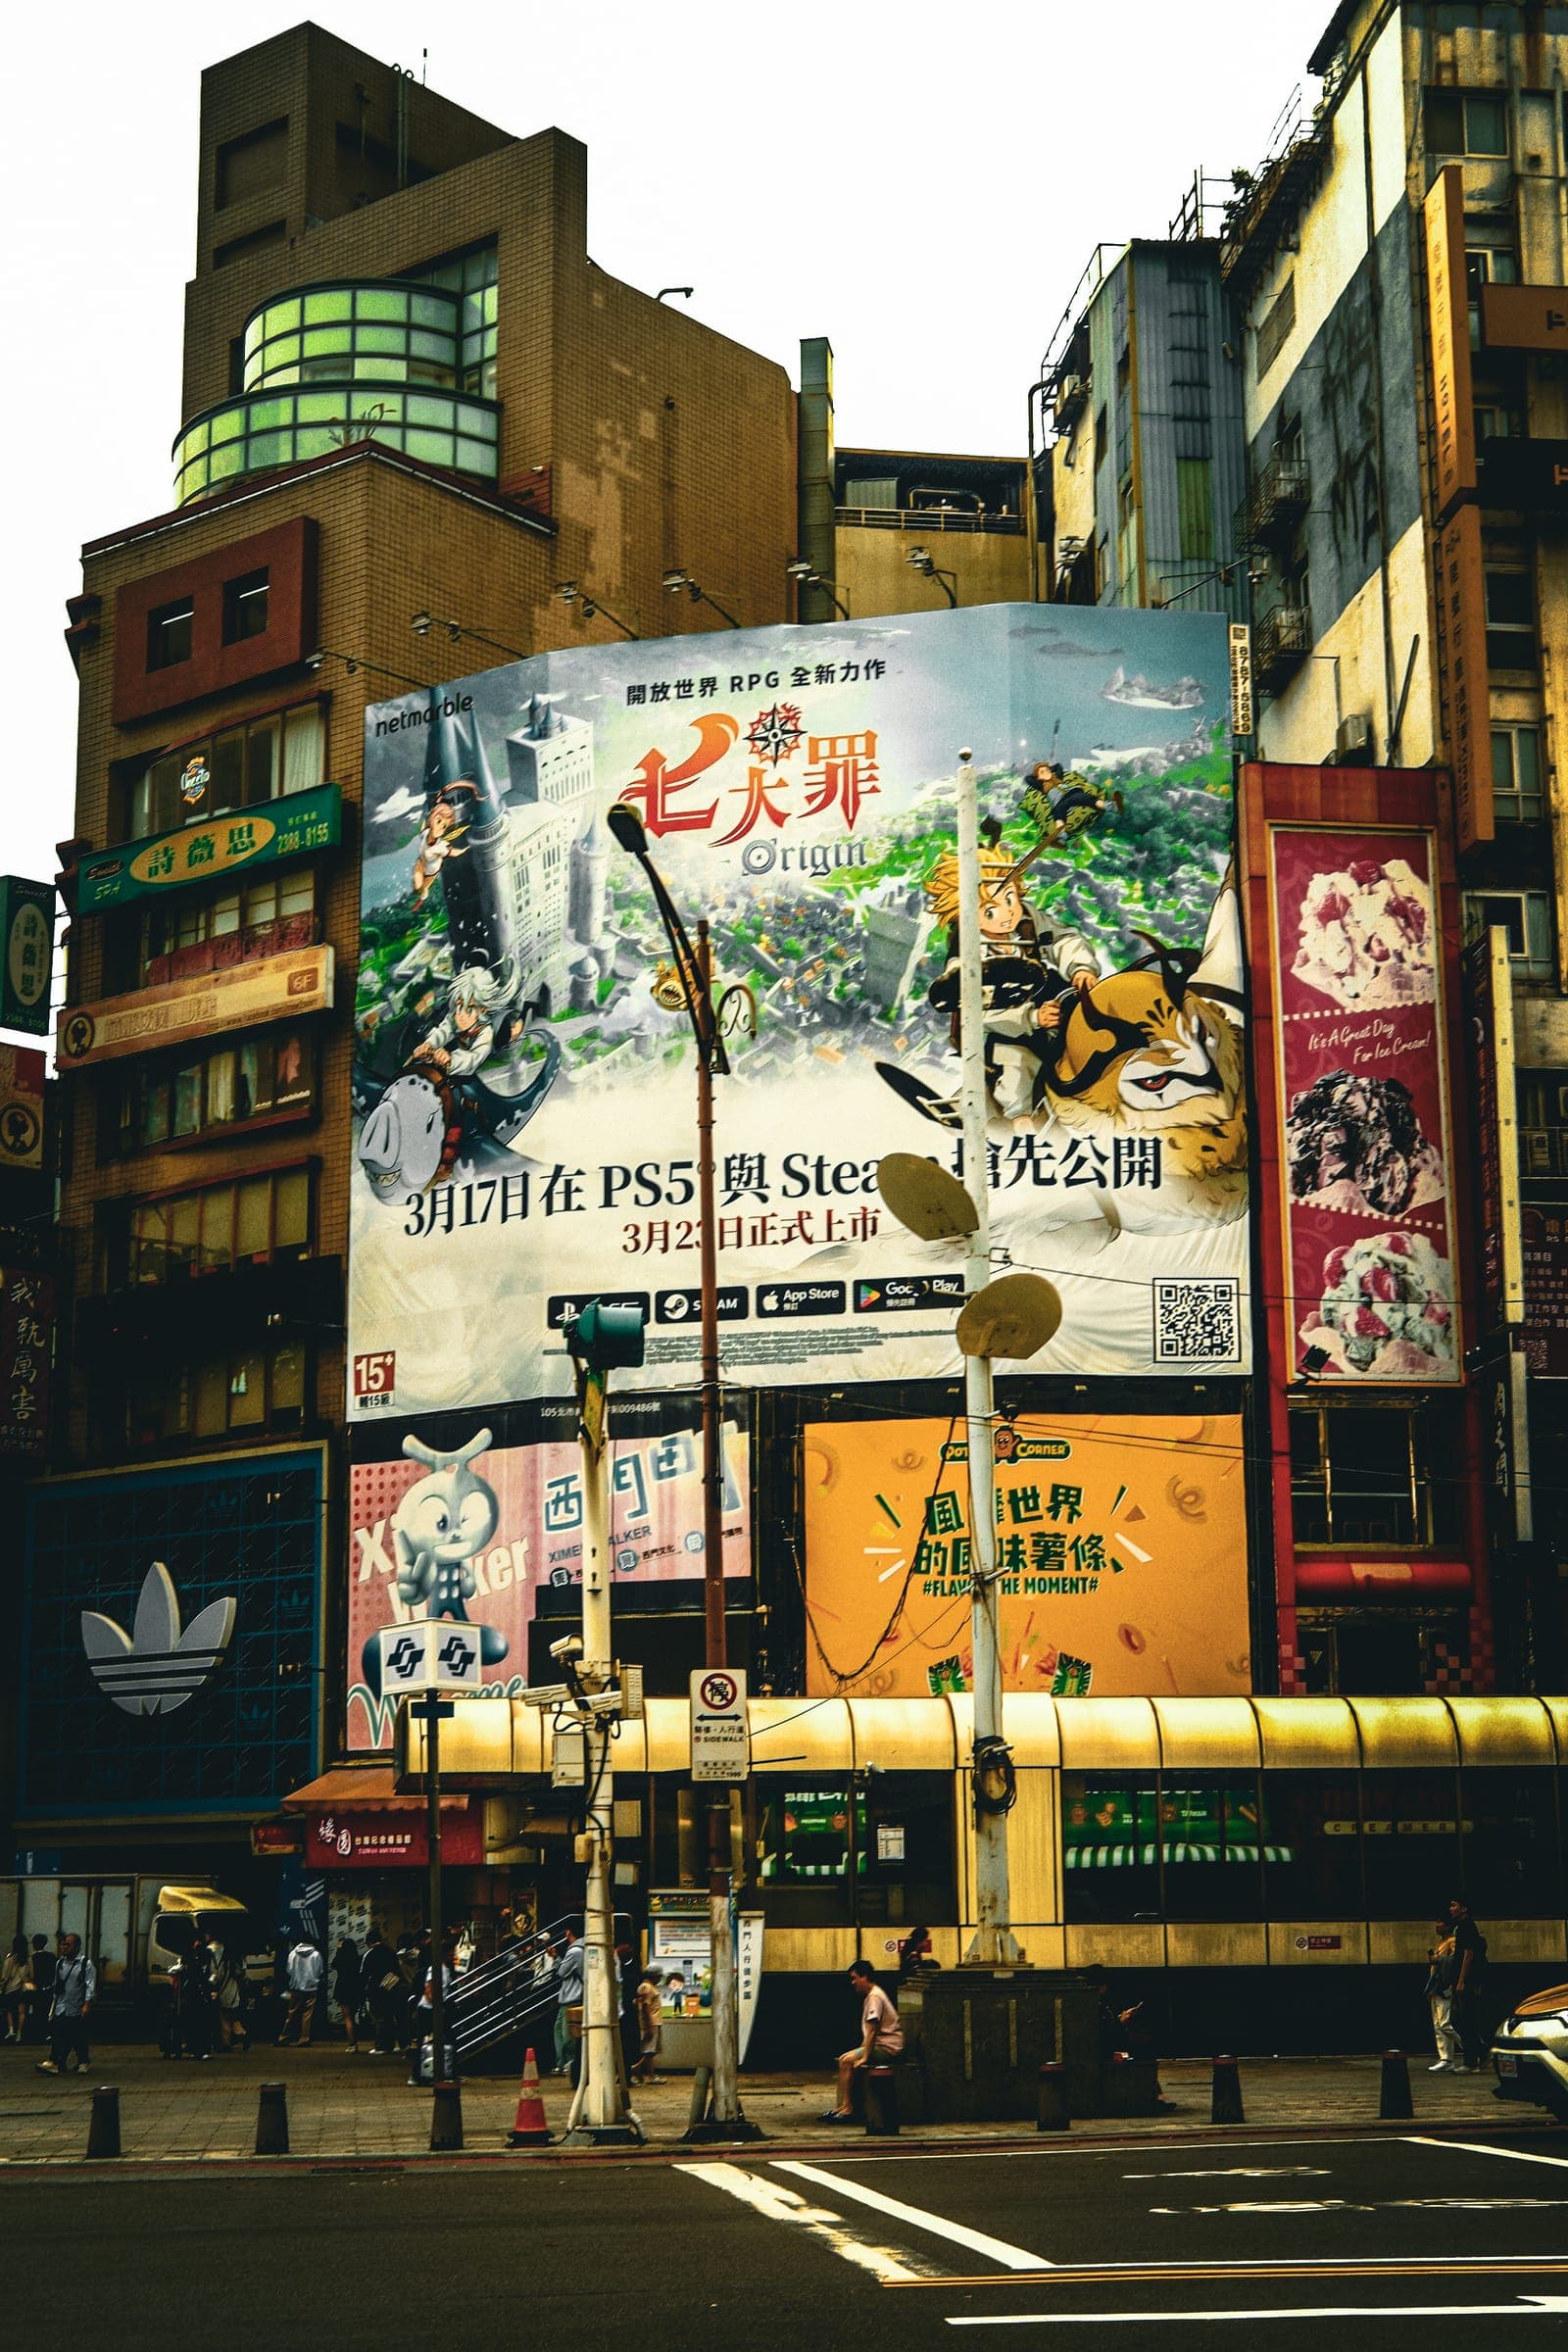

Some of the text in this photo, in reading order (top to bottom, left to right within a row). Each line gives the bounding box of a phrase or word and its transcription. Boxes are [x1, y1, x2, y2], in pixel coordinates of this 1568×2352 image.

[626, 659, 886, 706] 開放世界 RPG 全新力作
[375, 692, 474, 737] netmarble
[617, 712, 882, 849] 七大罪
[148, 822, 257, 878] 詩薇思
[742, 838, 867, 878] Origin
[1328, 1028, 1340, 1048] A
[1340, 1026, 1371, 1048] Great
[1373, 1019, 1396, 1039] Day
[1352, 1029, 1432, 1065] For Ice Cream!
[783, 1288, 840, 1303] App Store
[933, 1279, 959, 1294] Play
[692, 1298, 738, 1312] SAM
[356, 1353, 394, 1392] 15+
[925, 1483, 1084, 1536] 風世界
[549, 1544, 583, 1564] XIME
[1024, 1577, 1099, 1595] MOMENT#
[708, 1681, 729, 1702] 停
